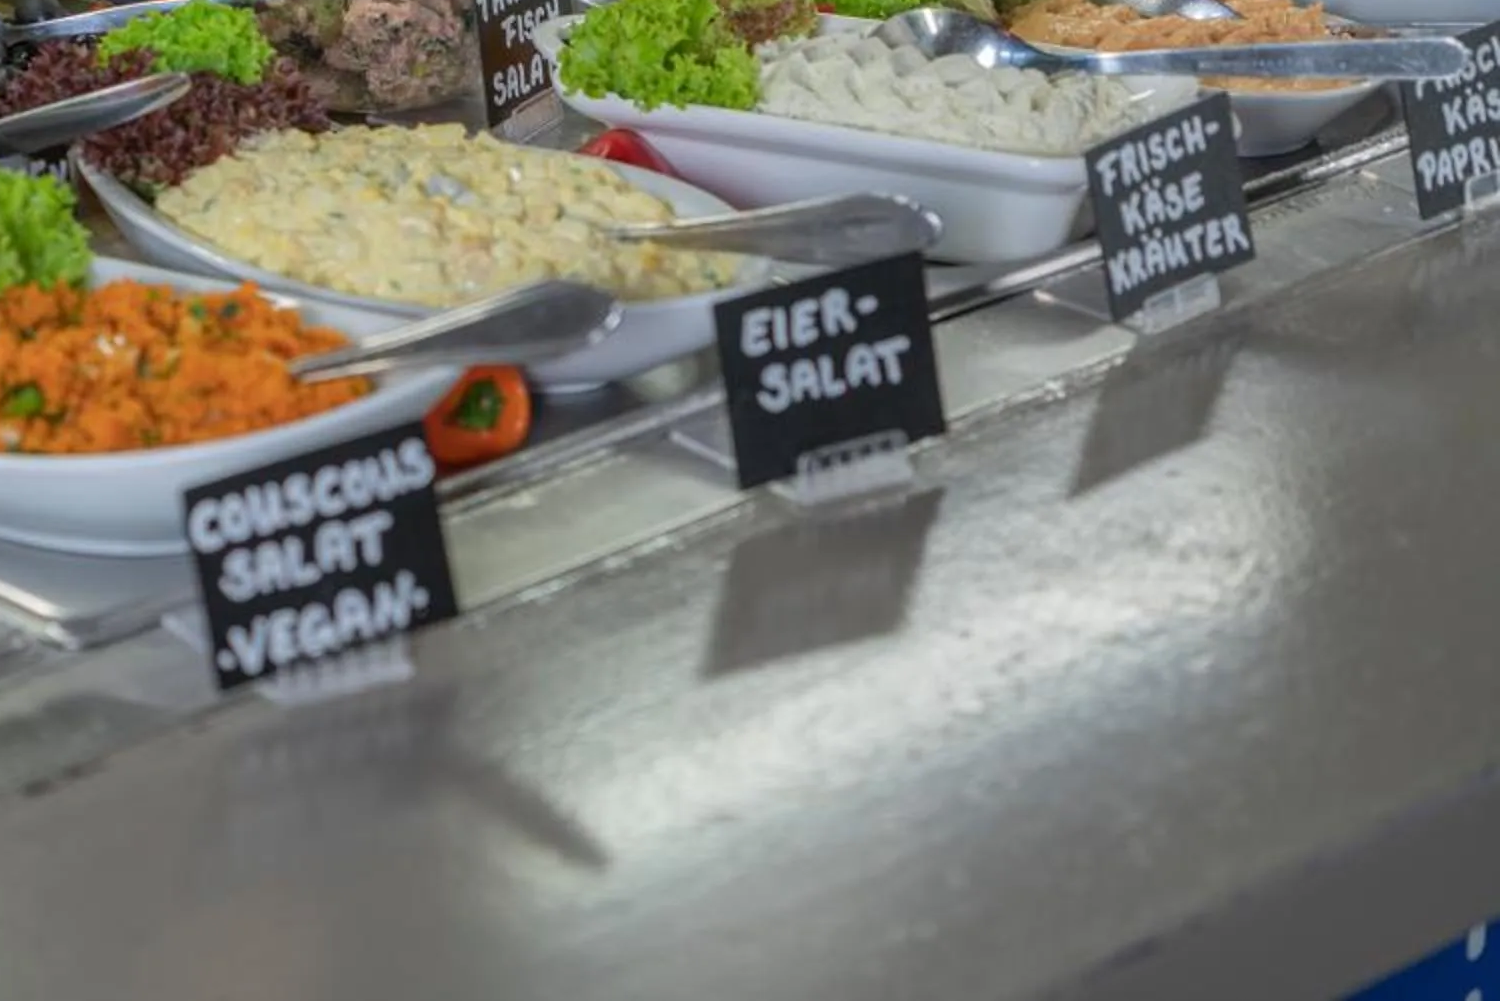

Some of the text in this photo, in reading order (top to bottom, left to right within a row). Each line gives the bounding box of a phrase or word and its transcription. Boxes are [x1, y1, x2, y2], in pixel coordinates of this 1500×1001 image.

[492, 53, 553, 106] SALA
[1095, 115, 1220, 197] FRISCH-
[1120, 171, 1205, 237] KÄSE
[1107, 212, 1250, 296] KRÄUTER
[740, 287, 880, 357] EIER-
[755, 334, 911, 415] SALAT
[188, 436, 436, 553] COUSCOUS
[217, 509, 395, 602] SALAT
